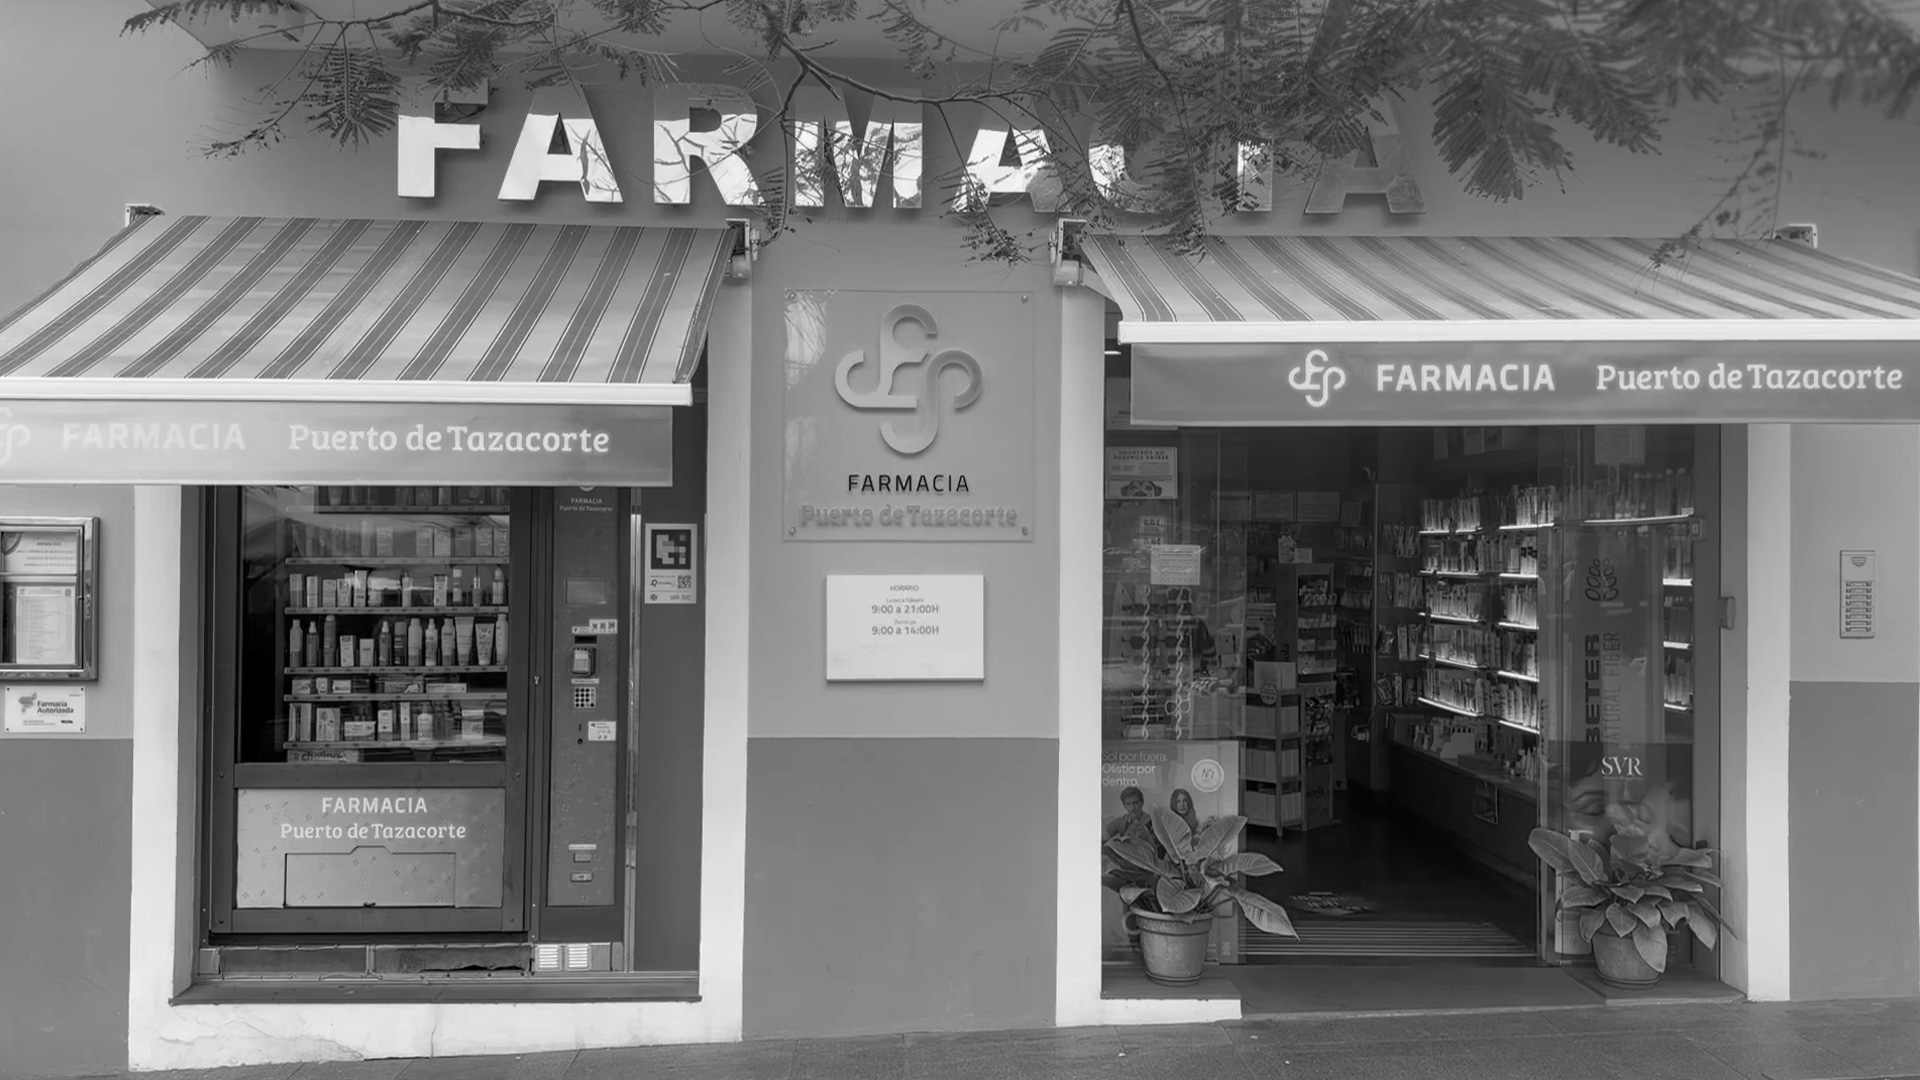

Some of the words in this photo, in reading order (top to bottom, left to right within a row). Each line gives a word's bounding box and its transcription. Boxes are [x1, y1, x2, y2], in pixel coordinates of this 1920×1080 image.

[398, 79, 1425, 214] FARMACIA
[1377, 363, 1555, 391] FARMACIA
[1596, 364, 1700, 391] Puerto
[1708, 364, 1743, 391] de
[1747, 363, 1903, 391] Tazacorte
[61, 422, 246, 450] FARMACIA
[288, 424, 398, 452] Puerto
[405, 424, 442, 452] de
[446, 425, 610, 453] Tazacorte
[848, 474, 969, 493] FARMACIA
[801, 505, 873, 528] Puerto
[880, 503, 904, 528] de
[906, 505, 1018, 528] Tazacorte
[889, 584, 920, 592] HORARIO
[871, 605, 894, 614] 9:00
[904, 604, 939, 614] 21:00H
[871, 626, 894, 636] 9:00
[905, 626, 939, 635] 14:00H
[1602, 632, 1621, 676] FIBER
[37, 700, 68, 708] Farmacia
[37, 706, 74, 714] Autorizada
[1102, 763, 1136, 774] Olistic
[1137, 765, 1156, 775] por
[1601, 756, 1644, 776] SVR
[1102, 776, 1140, 786] dentro.
[322, 797, 428, 813] FARMACIA
[280, 823, 343, 839] Puerto
[347, 823, 369, 839] de
[371, 823, 467, 839] Tazacorte
